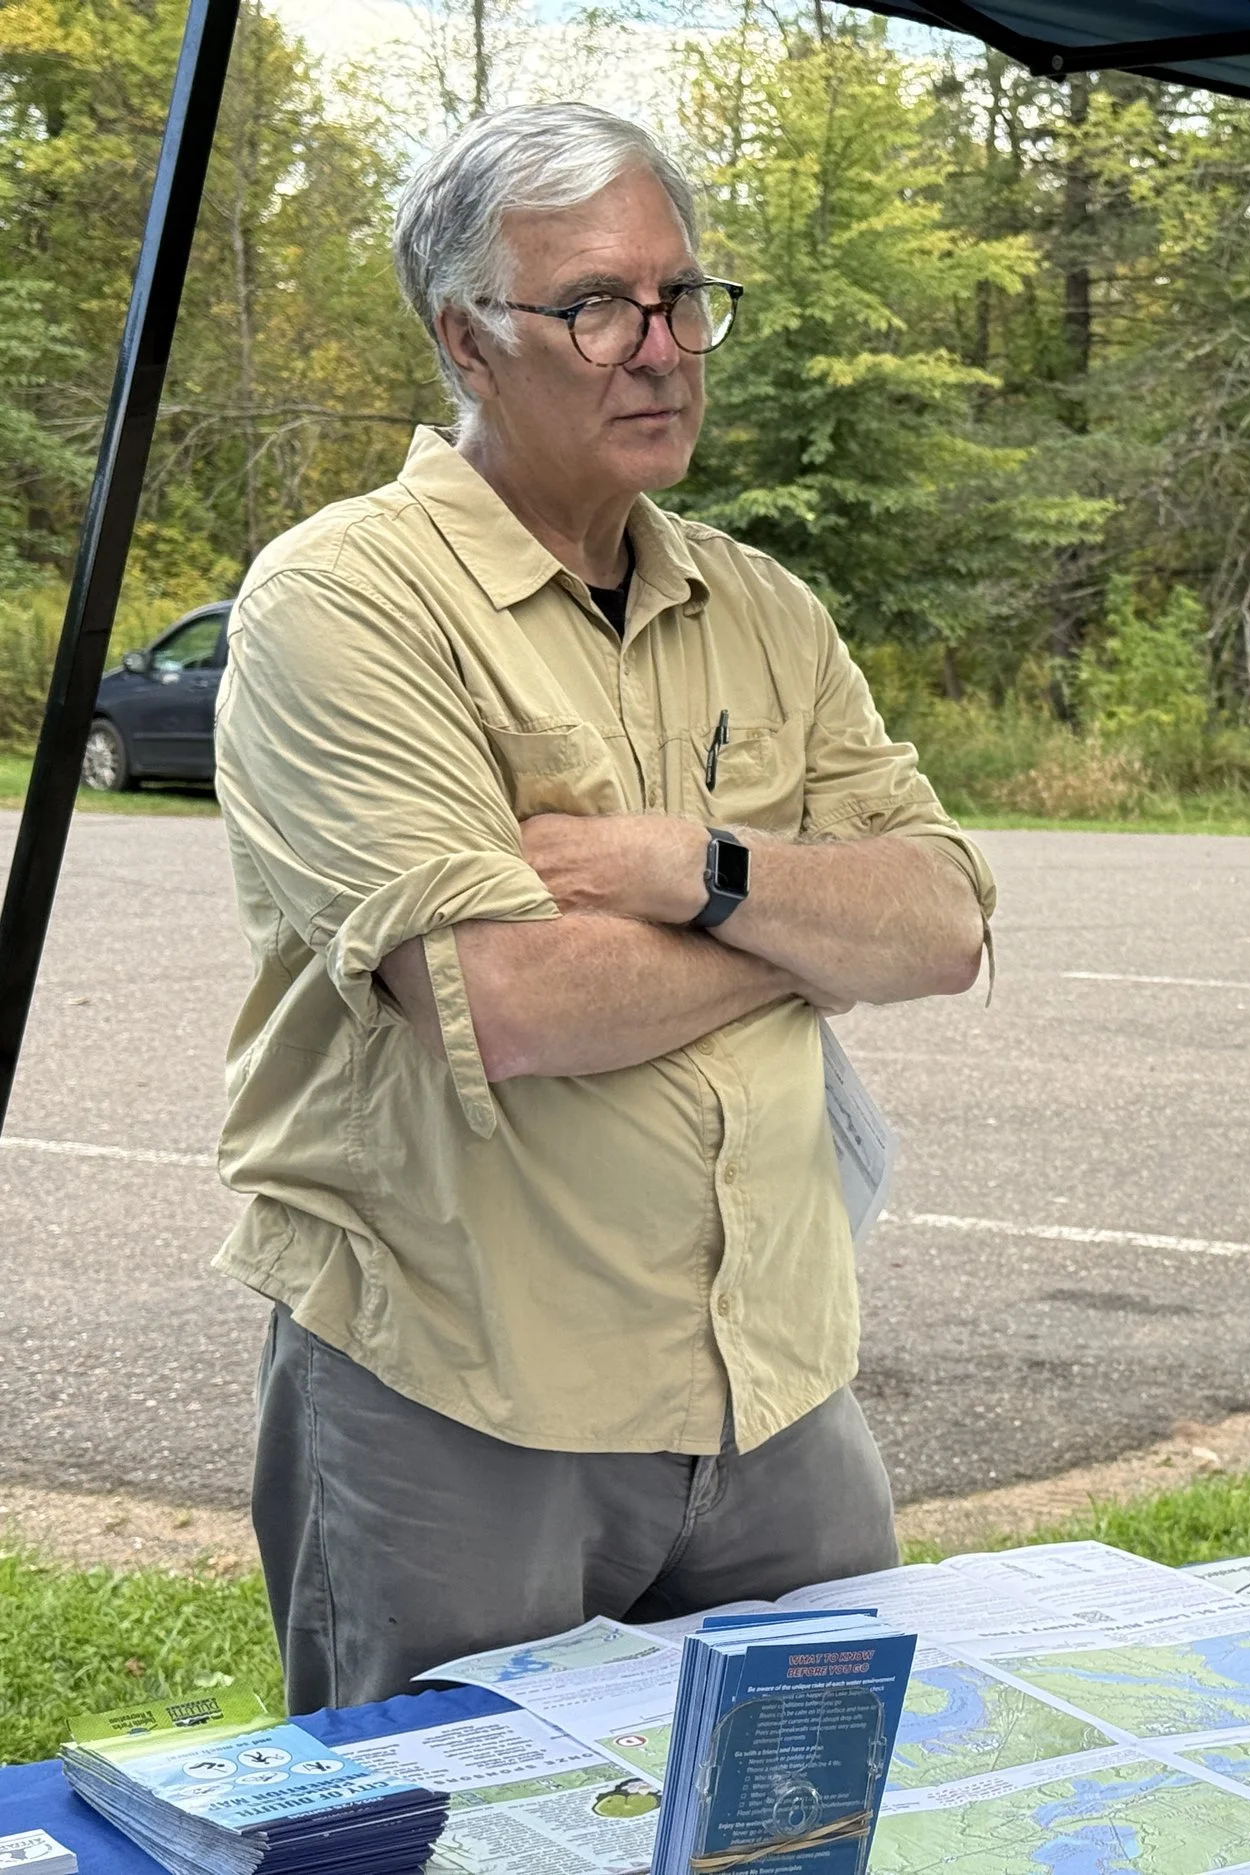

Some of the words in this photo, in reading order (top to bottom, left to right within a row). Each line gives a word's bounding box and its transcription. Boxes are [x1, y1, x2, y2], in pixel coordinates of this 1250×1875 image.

[789, 1654, 823, 1665] WHAT
[824, 1652, 839, 1663] TO
[840, 1650, 875, 1662] KNOW
[787, 1665, 828, 1678] BEFORE
[829, 1664, 851, 1676] YOU
[852, 1662, 869, 1673] GO
[543, 1752, 594, 1766] ONZE
[347, 1780, 390, 1794] CITY
[318, 1791, 341, 1801] OF
[235, 1796, 313, 1817] DULUTH
